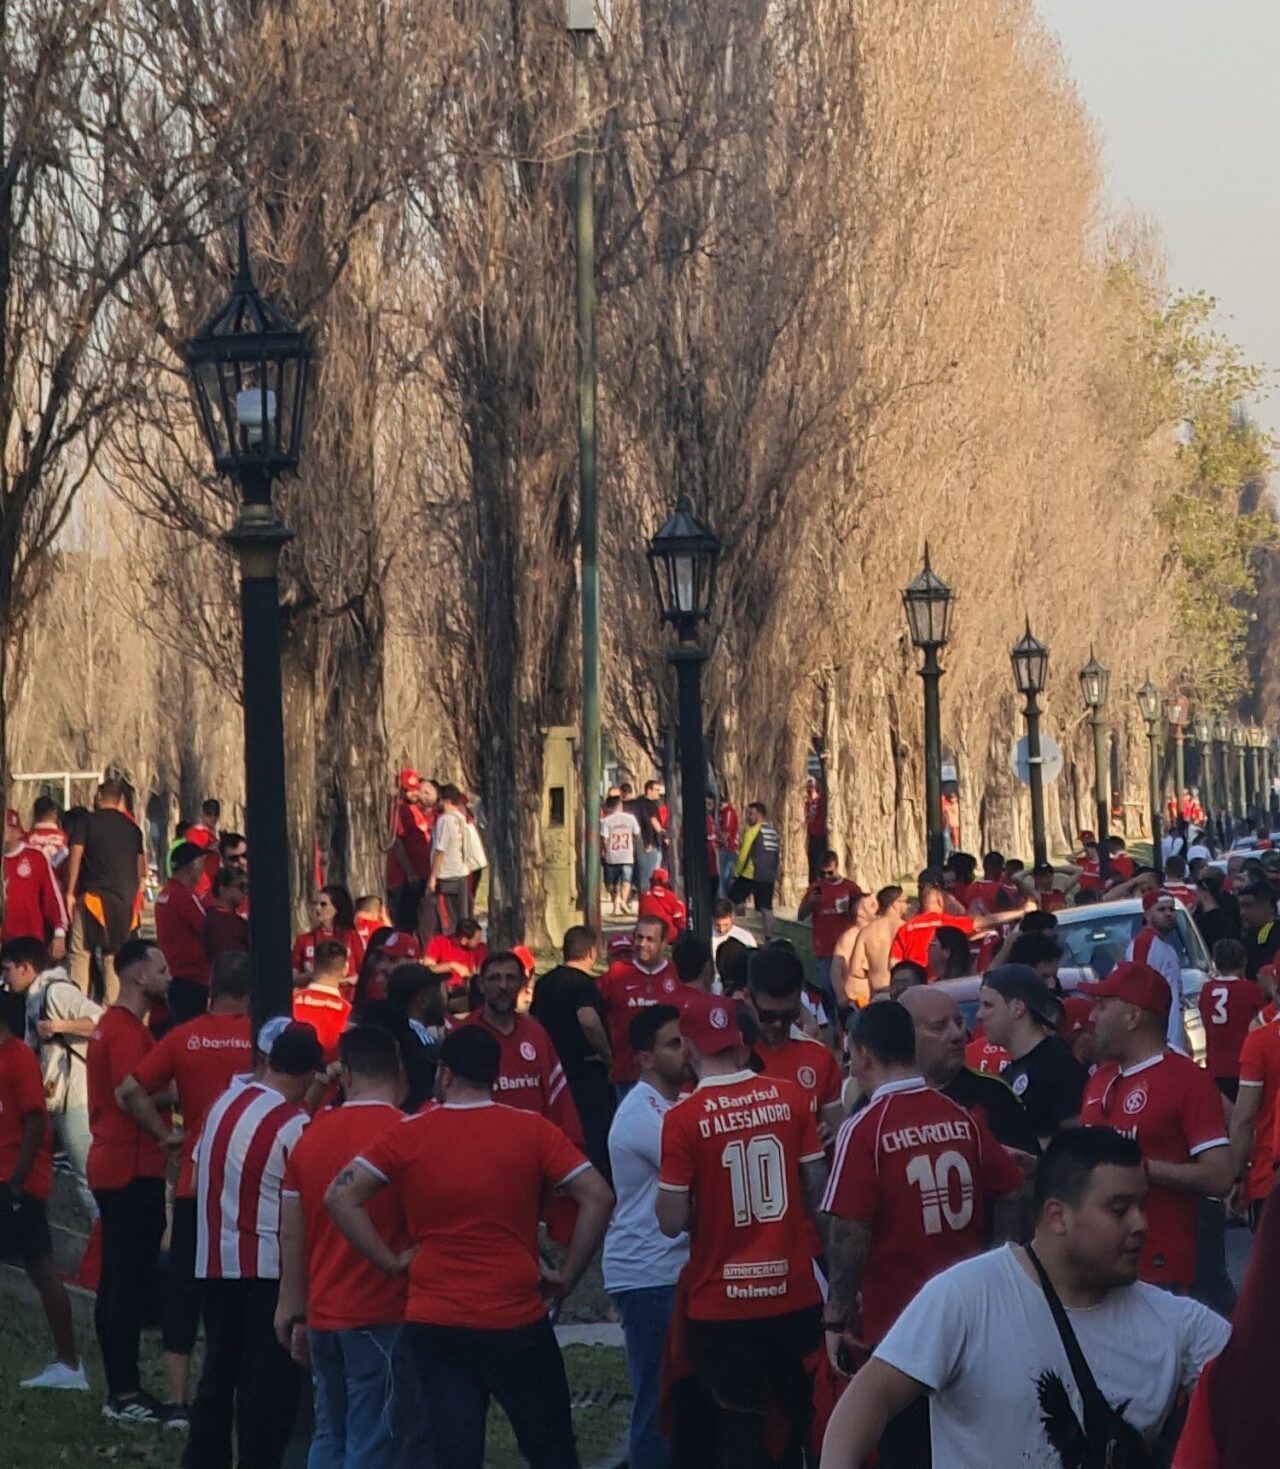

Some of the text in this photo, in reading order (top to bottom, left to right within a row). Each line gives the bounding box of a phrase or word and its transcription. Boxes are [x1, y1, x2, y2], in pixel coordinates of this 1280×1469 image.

[1211, 987, 1228, 1024] 3
[202, 1036, 252, 1048] banrisu
[718, 1084, 779, 1109] Banrisul
[881, 1120, 971, 1153] CHEVROLET
[721, 1133, 789, 1227] 10
[905, 1150, 974, 1235] 10
[726, 1281, 787, 1300] Unimed
